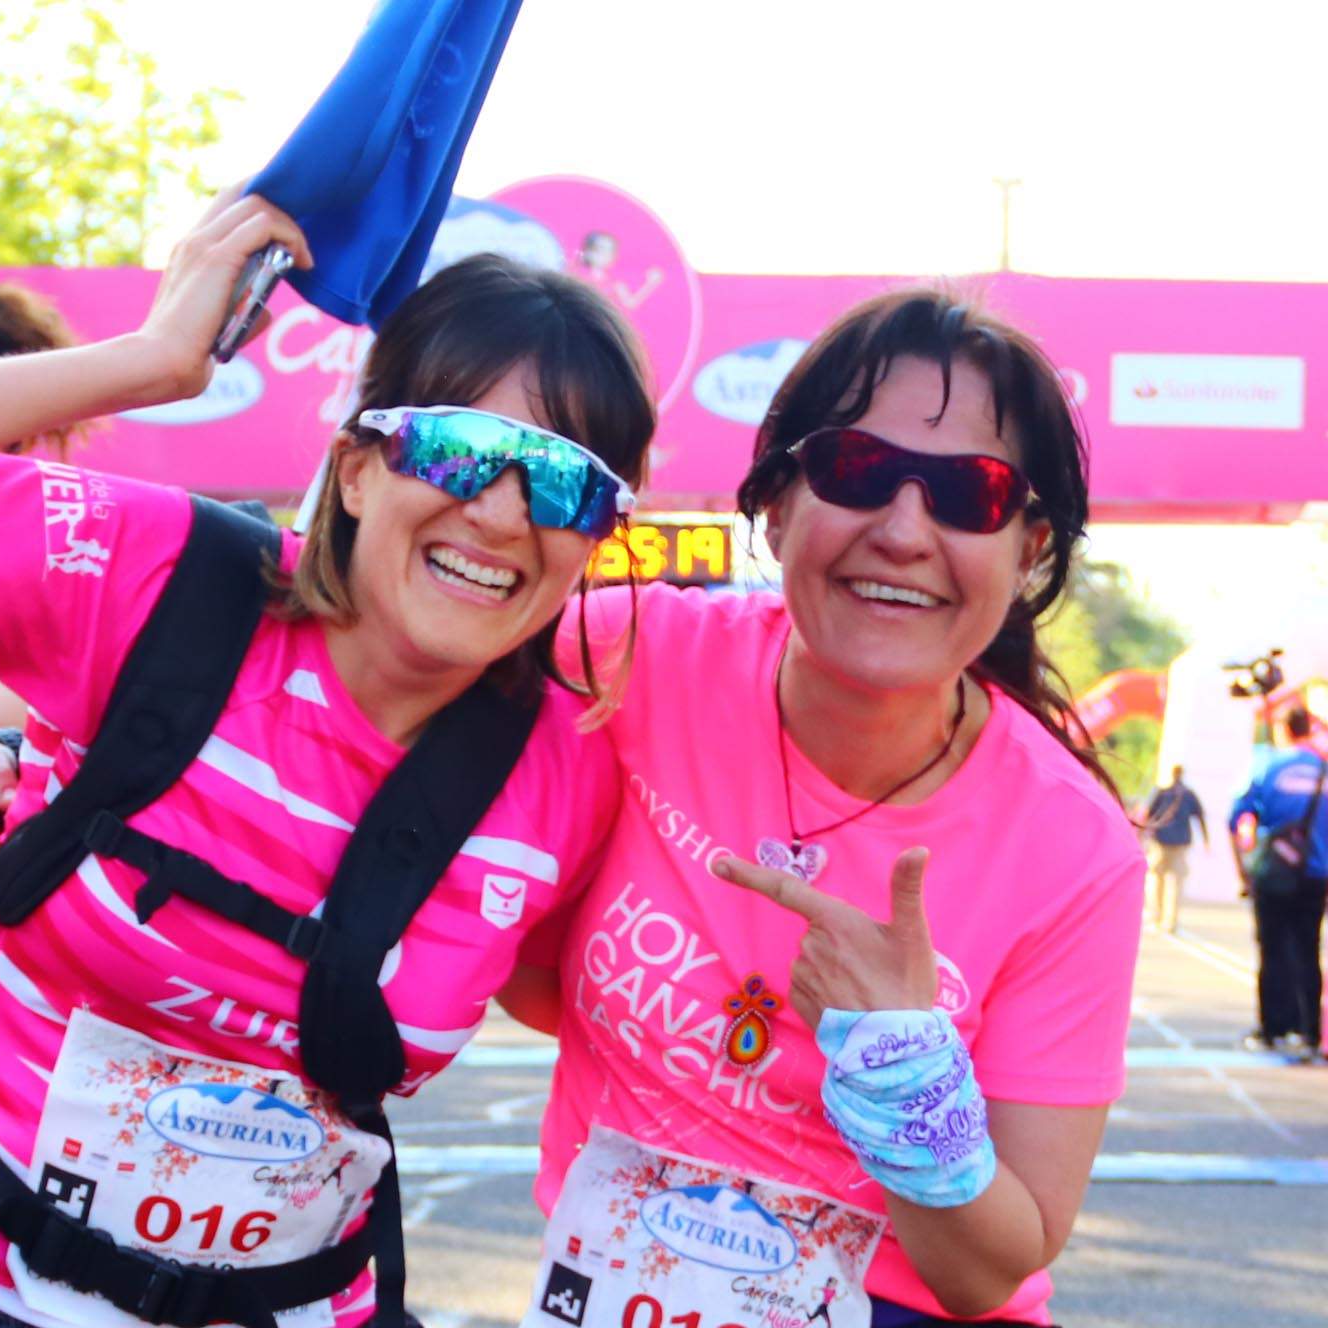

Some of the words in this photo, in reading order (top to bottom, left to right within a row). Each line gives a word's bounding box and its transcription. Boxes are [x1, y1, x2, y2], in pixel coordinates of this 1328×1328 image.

[603, 881, 721, 982] HOY
[156, 1098, 309, 1152] ASTURIANA
[134, 1195, 277, 1253] 016
[648, 1200, 783, 1266] ASTURIANA
